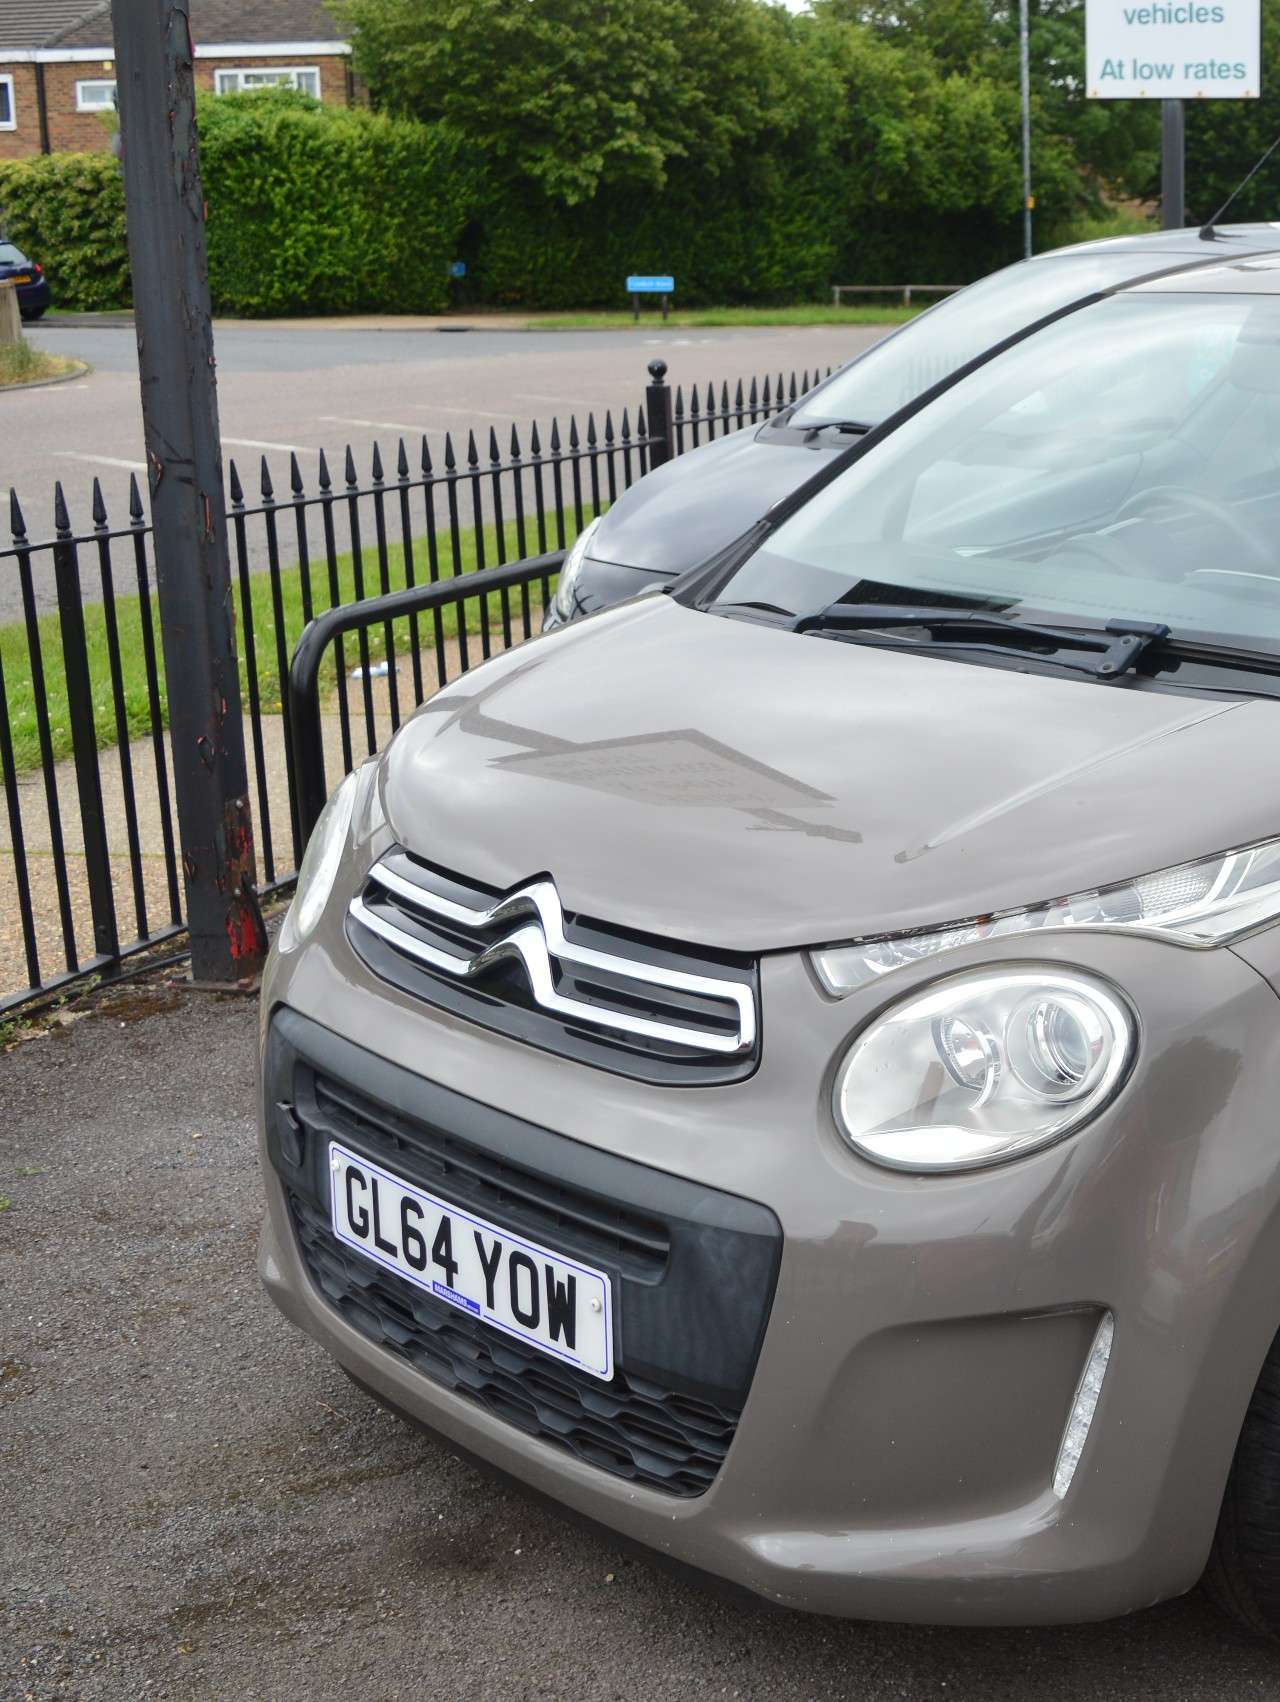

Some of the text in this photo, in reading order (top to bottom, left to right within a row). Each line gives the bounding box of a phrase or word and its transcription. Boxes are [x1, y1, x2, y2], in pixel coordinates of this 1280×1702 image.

[1123, 2, 1225, 25] vehicles
[1100, 58, 1247, 80] At low rates
[345, 1164, 576, 1351] GL64 YOW
